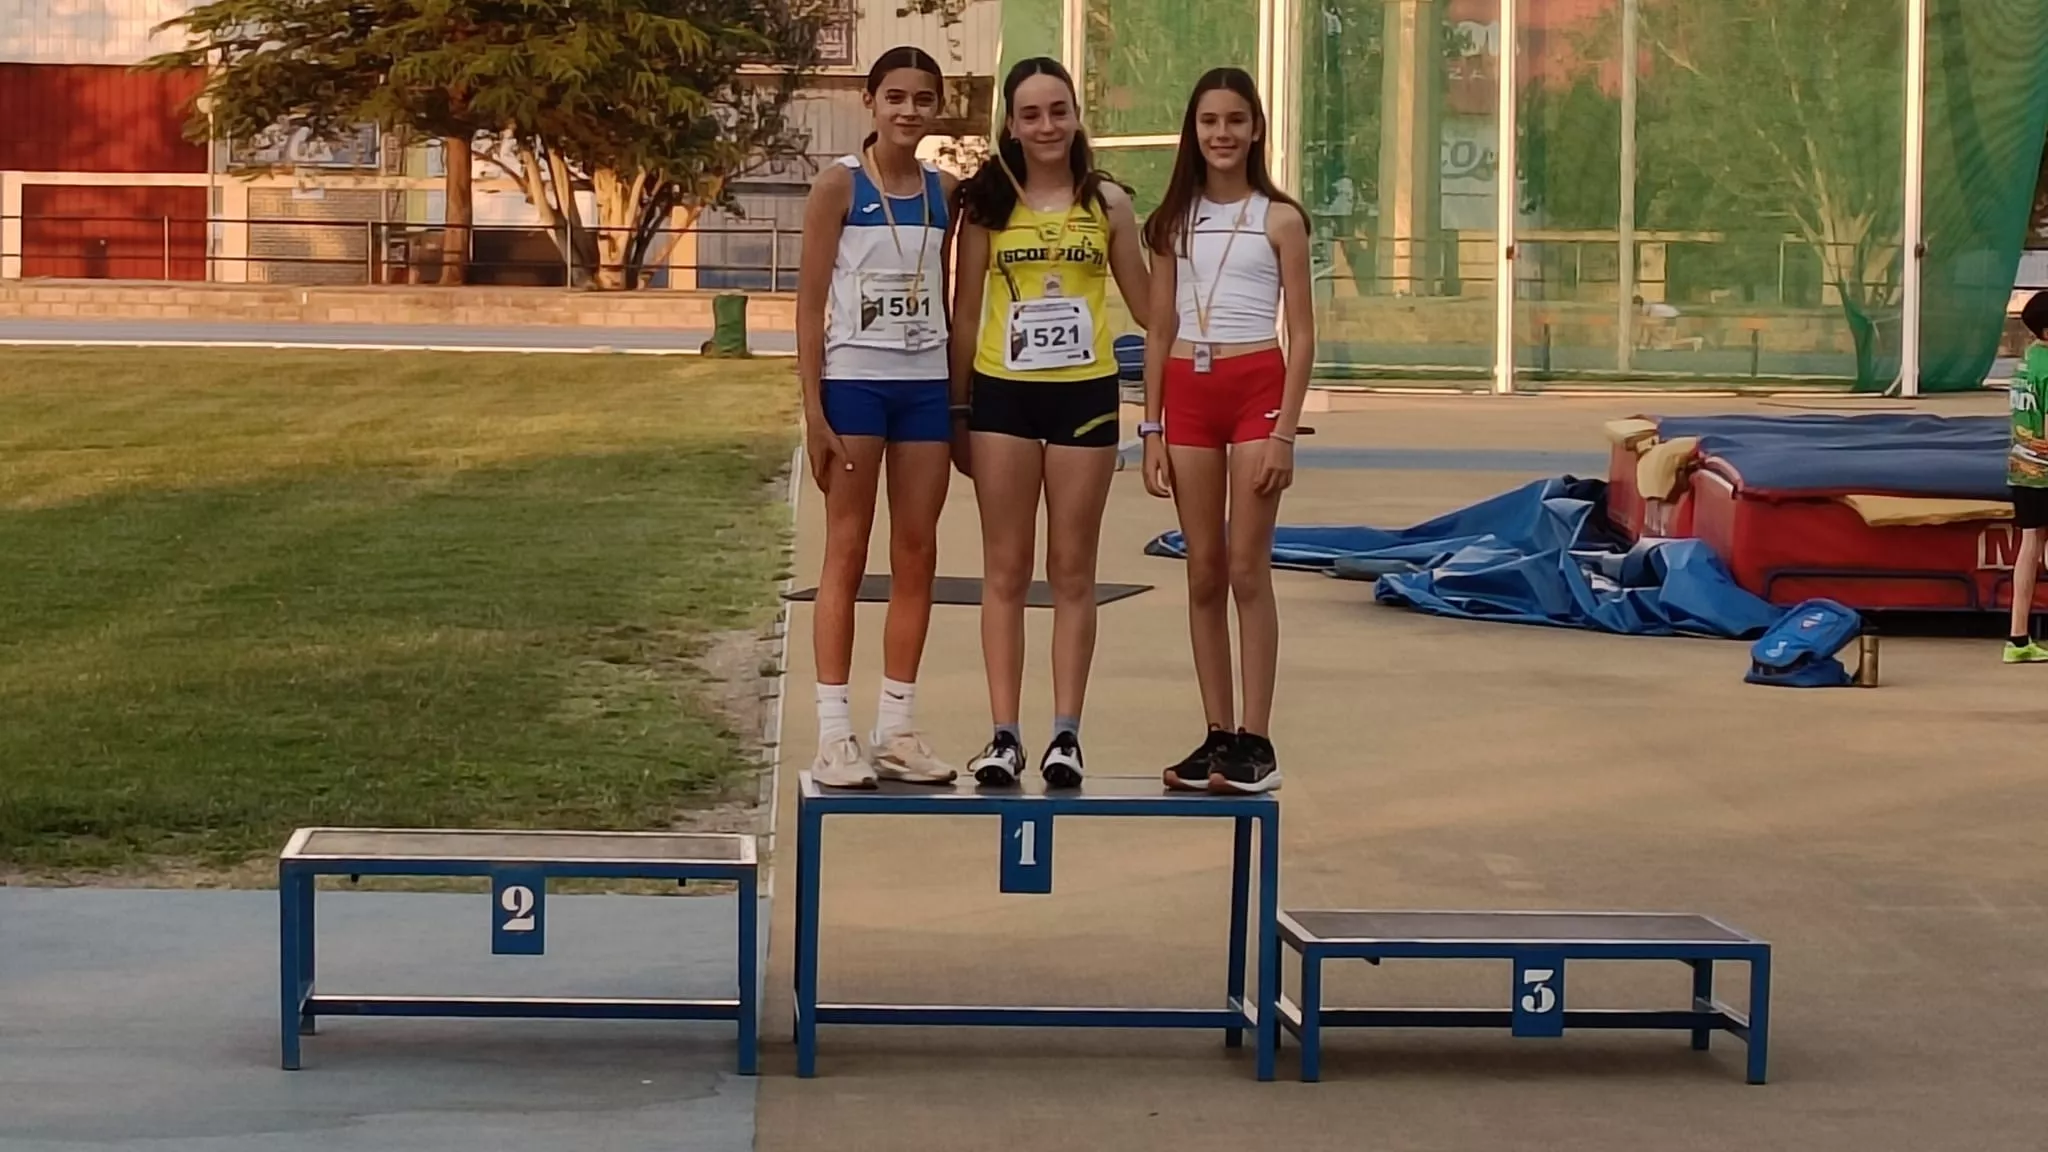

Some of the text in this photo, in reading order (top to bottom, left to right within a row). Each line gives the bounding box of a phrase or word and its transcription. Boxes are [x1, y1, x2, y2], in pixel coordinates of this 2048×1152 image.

[877, 296, 930, 317] 1591
[1021, 324, 1080, 348] 1521
[1013, 820, 1037, 865] 1
[501, 885, 535, 931] 2
[1521, 969, 1556, 1013] 3
